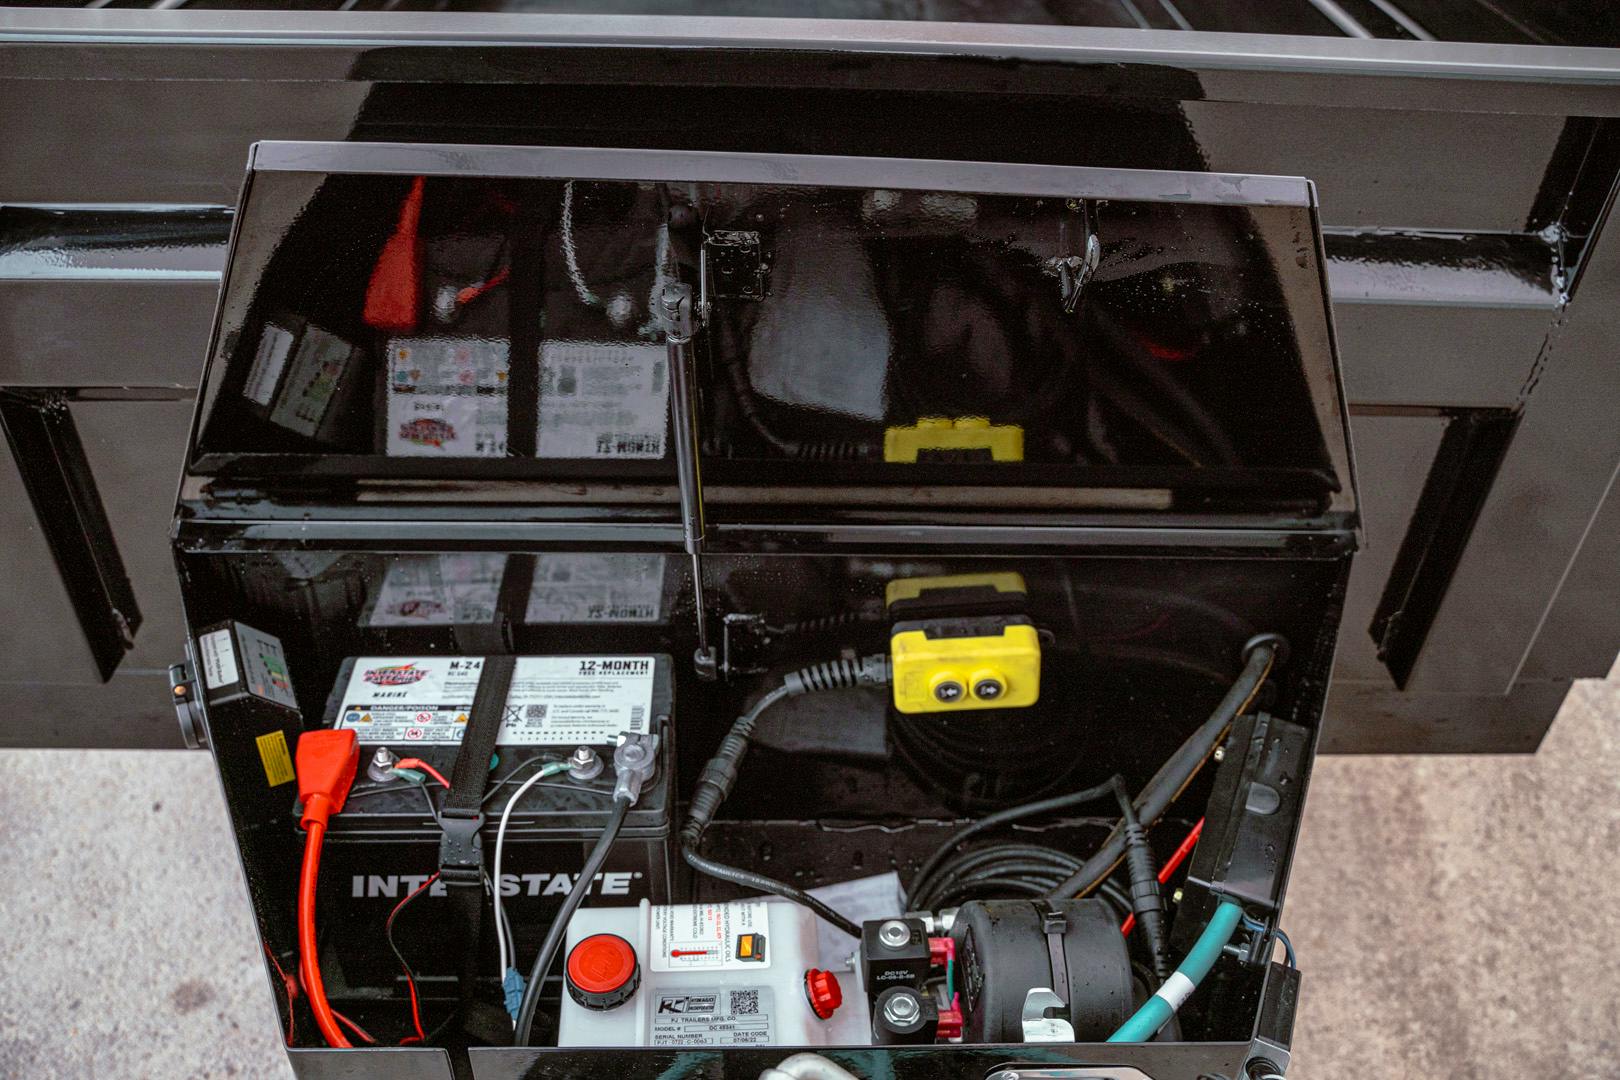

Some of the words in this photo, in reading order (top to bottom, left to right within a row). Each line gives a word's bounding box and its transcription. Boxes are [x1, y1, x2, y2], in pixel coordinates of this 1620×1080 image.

[449, 661, 481, 670] M-24
[579, 660, 649, 671] 12-MONTH
[352, 872, 633, 898] INTESTATE
